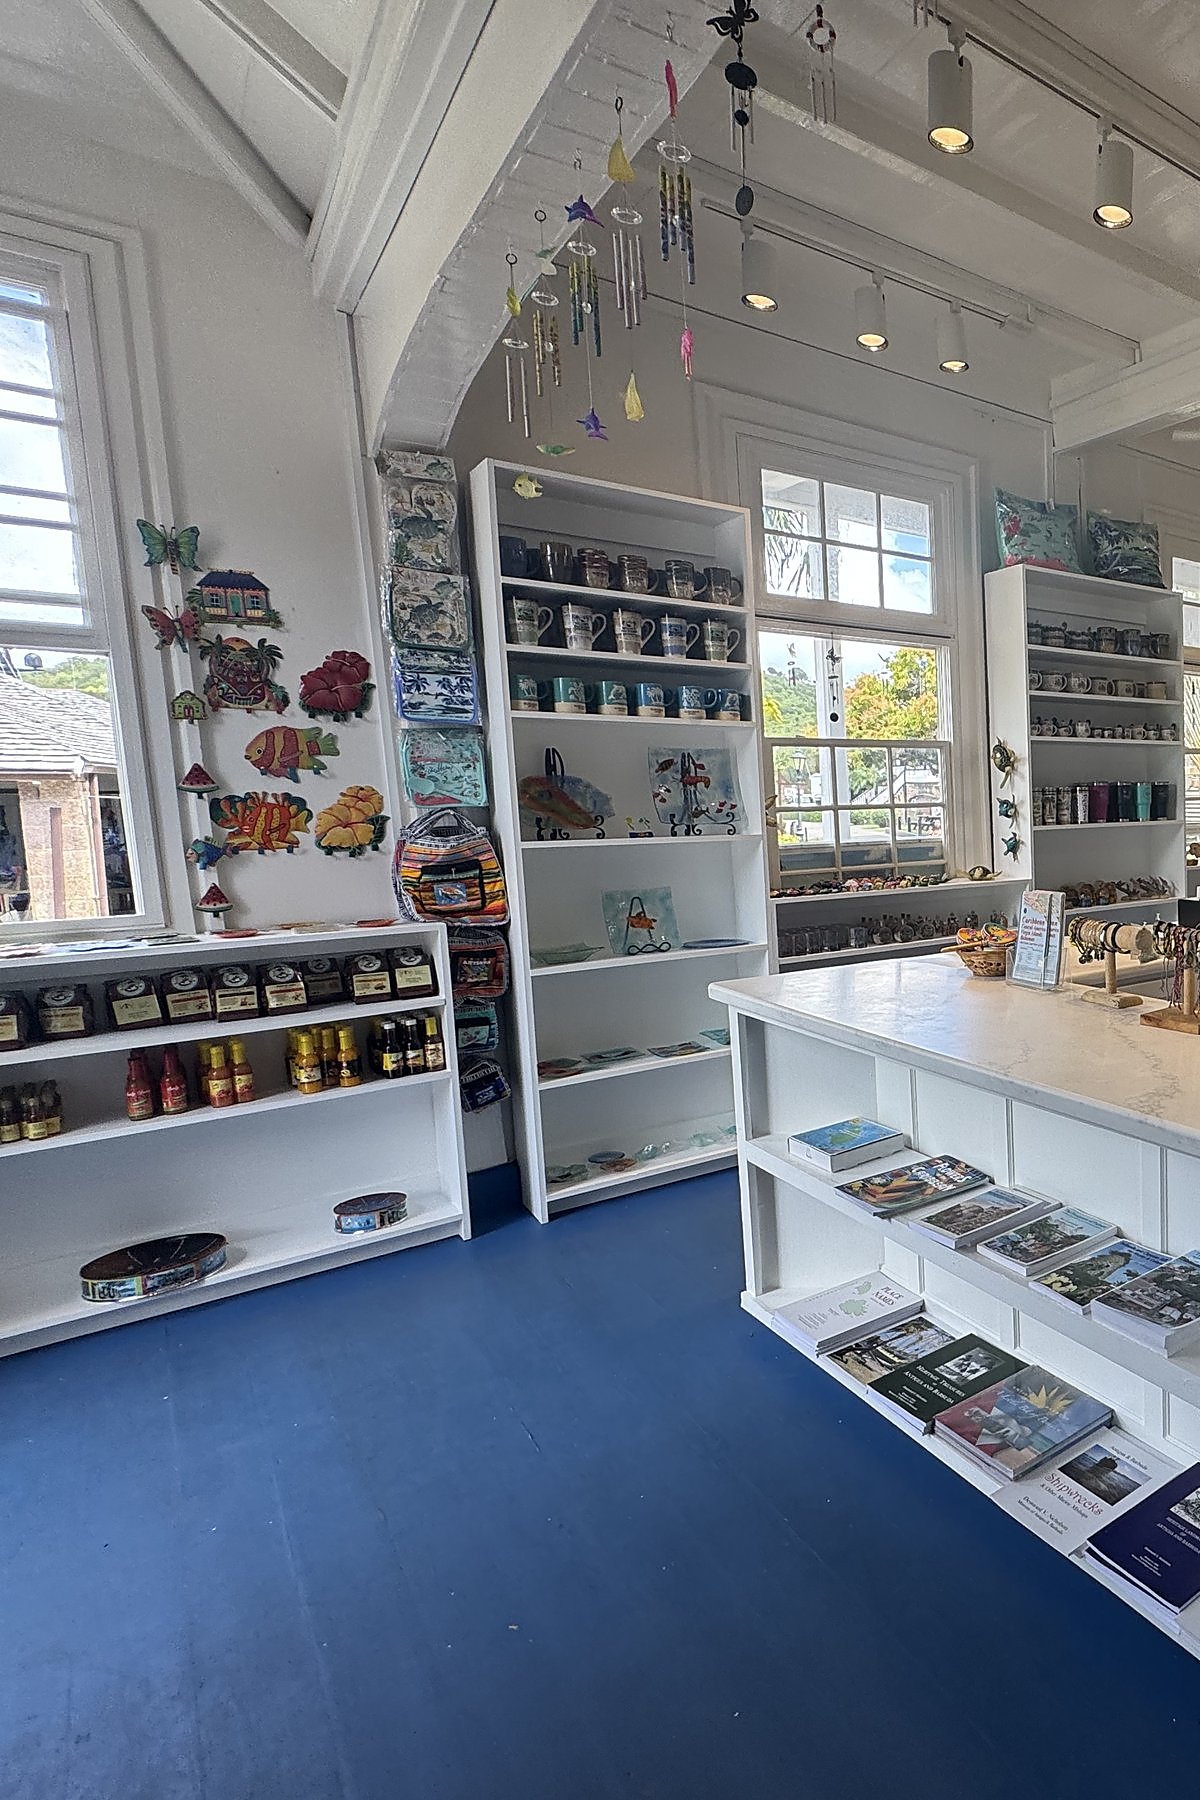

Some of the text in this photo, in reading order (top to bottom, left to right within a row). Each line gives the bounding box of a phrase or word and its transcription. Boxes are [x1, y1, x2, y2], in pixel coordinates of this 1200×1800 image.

[872, 1291, 897, 1306] NAMES
[881, 1286, 905, 1300] PLACE
[932, 1388, 955, 1404] BARBUDA
[1044, 1472, 1104, 1516] Shipwrecks
